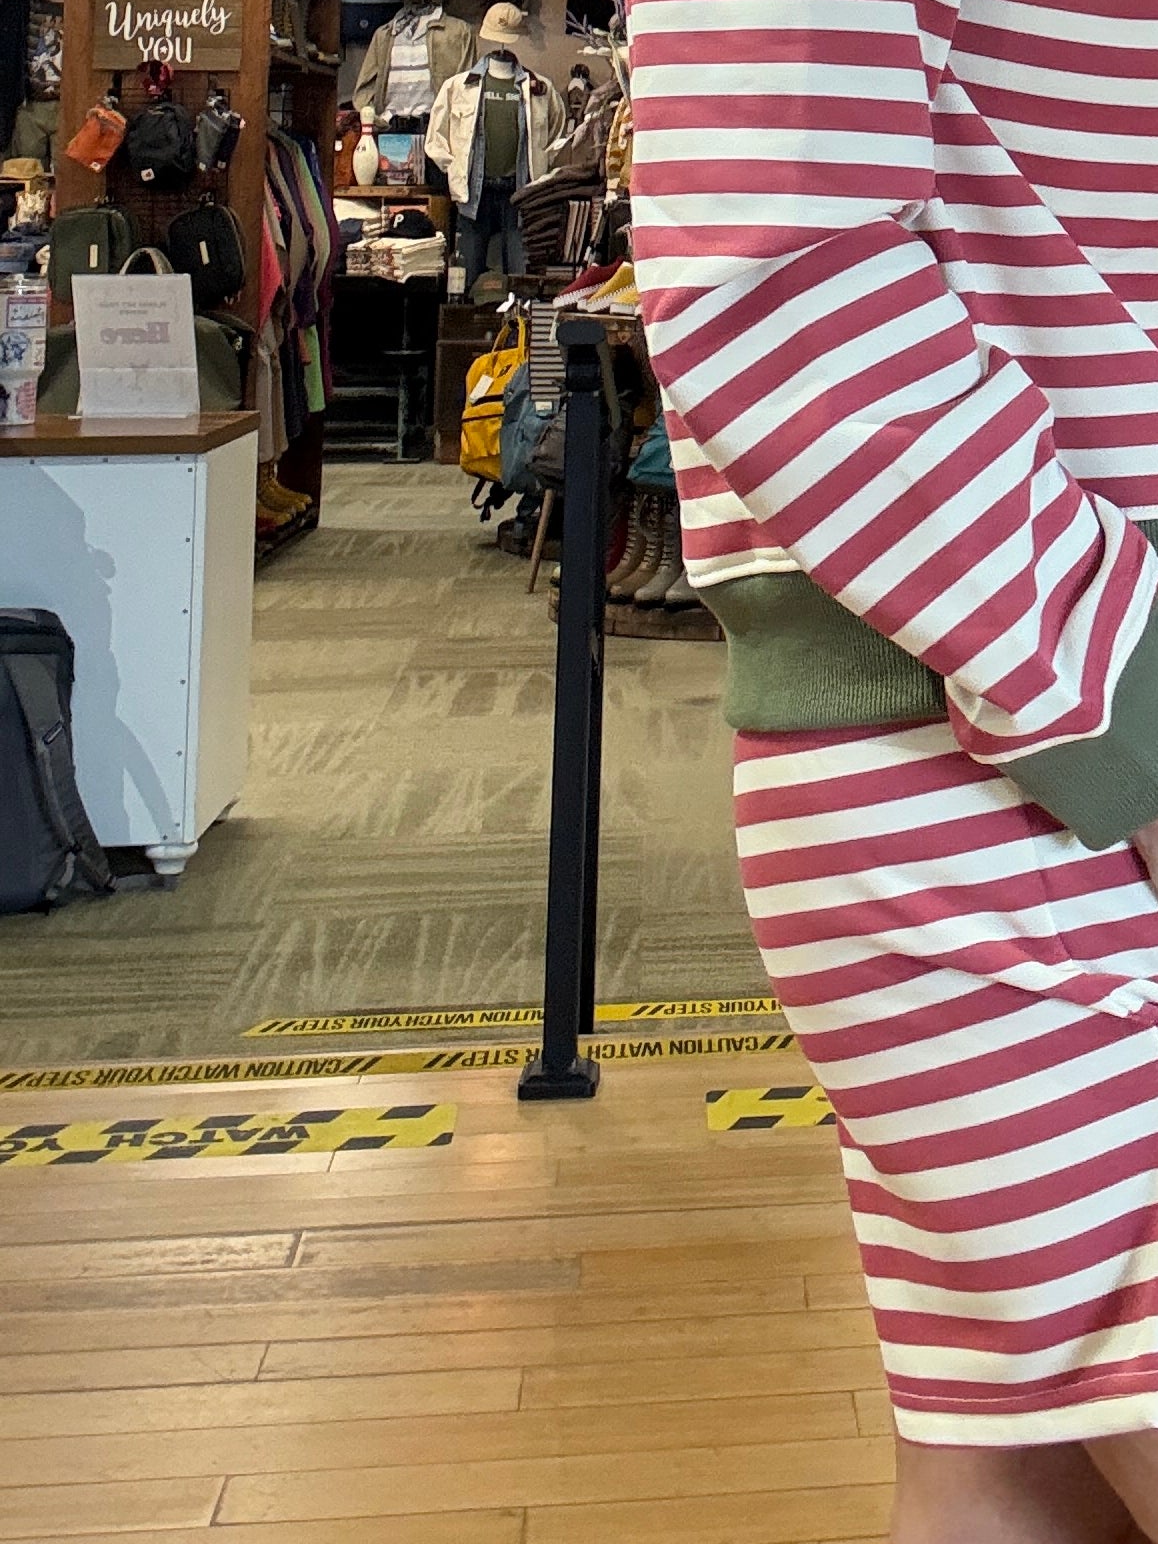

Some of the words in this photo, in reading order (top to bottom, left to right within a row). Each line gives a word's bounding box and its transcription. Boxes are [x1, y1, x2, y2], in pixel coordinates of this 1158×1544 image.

[137, 36, 192, 64] YOU
[393, 213, 404, 228] P
[663, 1001, 713, 1015] STEP
[717, 999, 764, 1013] YOUR
[293, 1018, 347, 1032] STEP
[350, 1015, 401, 1030] YOUR
[406, 1013, 474, 1027] WATCH
[479, 1009, 544, 1023] AUTION
[587, 1041, 663, 1060] WATCH
[669, 1036, 760, 1055] CAUTION
[461, 1048, 519, 1066] STEP
[93, 1067, 154, 1086] YOUR
[158, 1063, 241, 1082] WATCH
[243, 1057, 343, 1079] CAUTION
[26, 1069, 91, 1088] STEP
[0, 1137, 65, 1153] YO
[105, 1125, 311, 1149] WATCH
